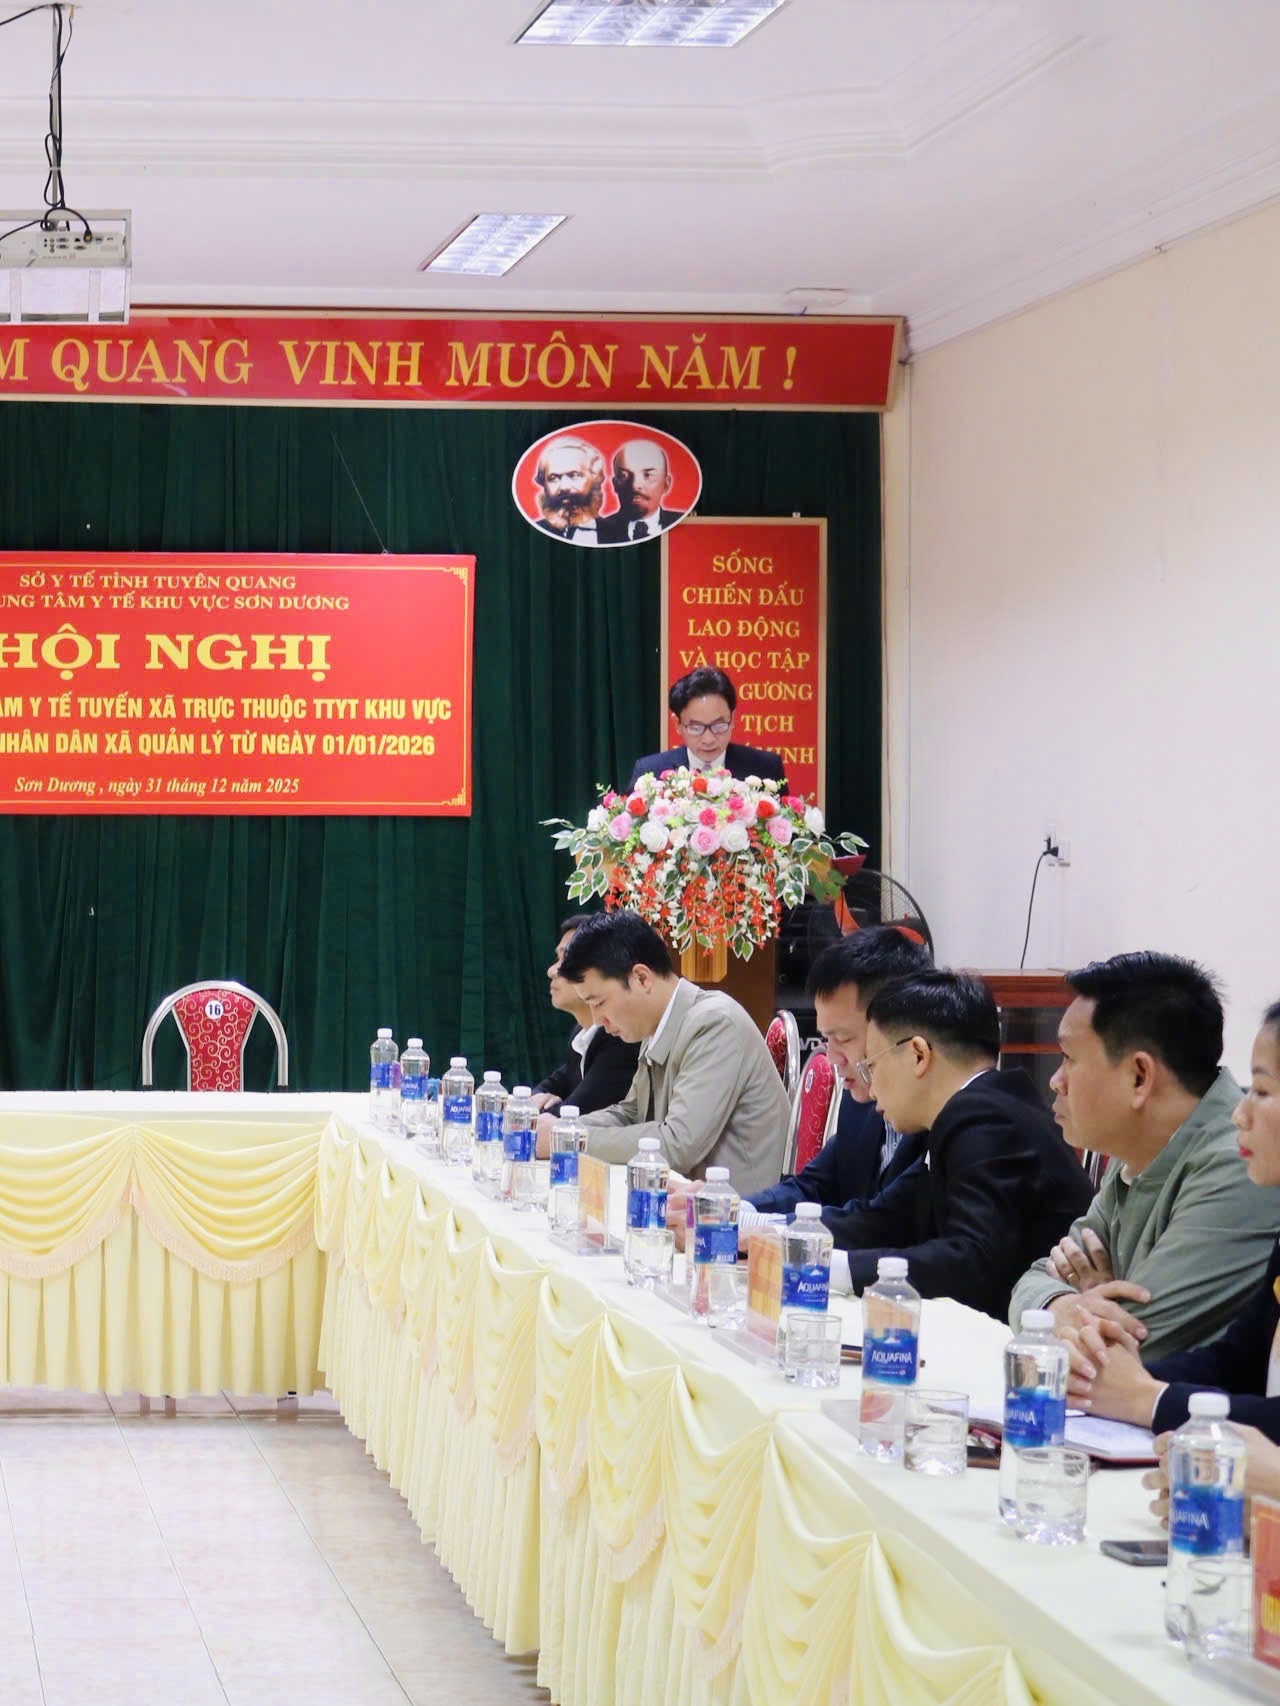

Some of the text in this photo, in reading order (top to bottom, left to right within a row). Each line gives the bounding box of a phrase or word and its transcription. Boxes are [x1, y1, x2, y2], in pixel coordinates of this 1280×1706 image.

[51, 338, 252, 392] QUANG
[279, 340, 424, 386] VINH
[445, 331, 618, 388] MUÔN
[636, 333, 767, 390] NĂM
[712, 548, 774, 574] SỐNG
[19, 569, 297, 592] SỞ Y TẾ TỈNH TUYÊN QUANG
[40, 592, 85, 609] TÂM
[90, 595, 104, 609] Y
[108, 590, 136, 609] TẾ
[140, 595, 183, 609] KHU
[189, 595, 230, 612] VỰC
[233, 594, 273, 610] SƠN
[278, 594, 351, 610] DƯƠNG
[682, 581, 804, 606] CHIẾN ĐẤU
[687, 616, 801, 641] LAO ĐỘNG
[145, 633, 332, 683] NGHỊ
[680, 648, 811, 673] VÀ HỌC TẬP
[738, 681, 813, 702] GƯƠNG
[29, 696, 42, 718] Y
[48, 691, 73, 718] TẾ
[78, 691, 143, 719] TUYẾN
[149, 694, 177, 719] XÃ
[182, 696, 235, 723] TRỰC
[241, 694, 307, 723] THUỘC
[313, 698, 360, 720] TTYT
[365, 698, 406, 720] KHU
[412, 698, 452, 724] VỰC
[741, 715, 795, 735] TỊCH
[55, 729, 98, 754] DÂN
[104, 730, 133, 754] XÃ
[138, 727, 195, 757] QUẢN
[201, 730, 225, 755] LÝ
[230, 730, 258, 755] TỪ
[261, 730, 317, 755] NGÀY
[322, 734, 436, 756] 01/01/2026
[14, 776, 44, 793] Sơn
[47, 776, 97, 797] Dương
[107, 777, 143, 797] ngày
[146, 777, 163, 793] 31
[166, 777, 207, 797] tháng
[210, 777, 228, 793] 12
[231, 778, 262, 793] năm
[265, 778, 300, 794] 2025
[209, 1004, 221, 1016] 16
[871, 1350, 913, 1364] AQUAFINA
